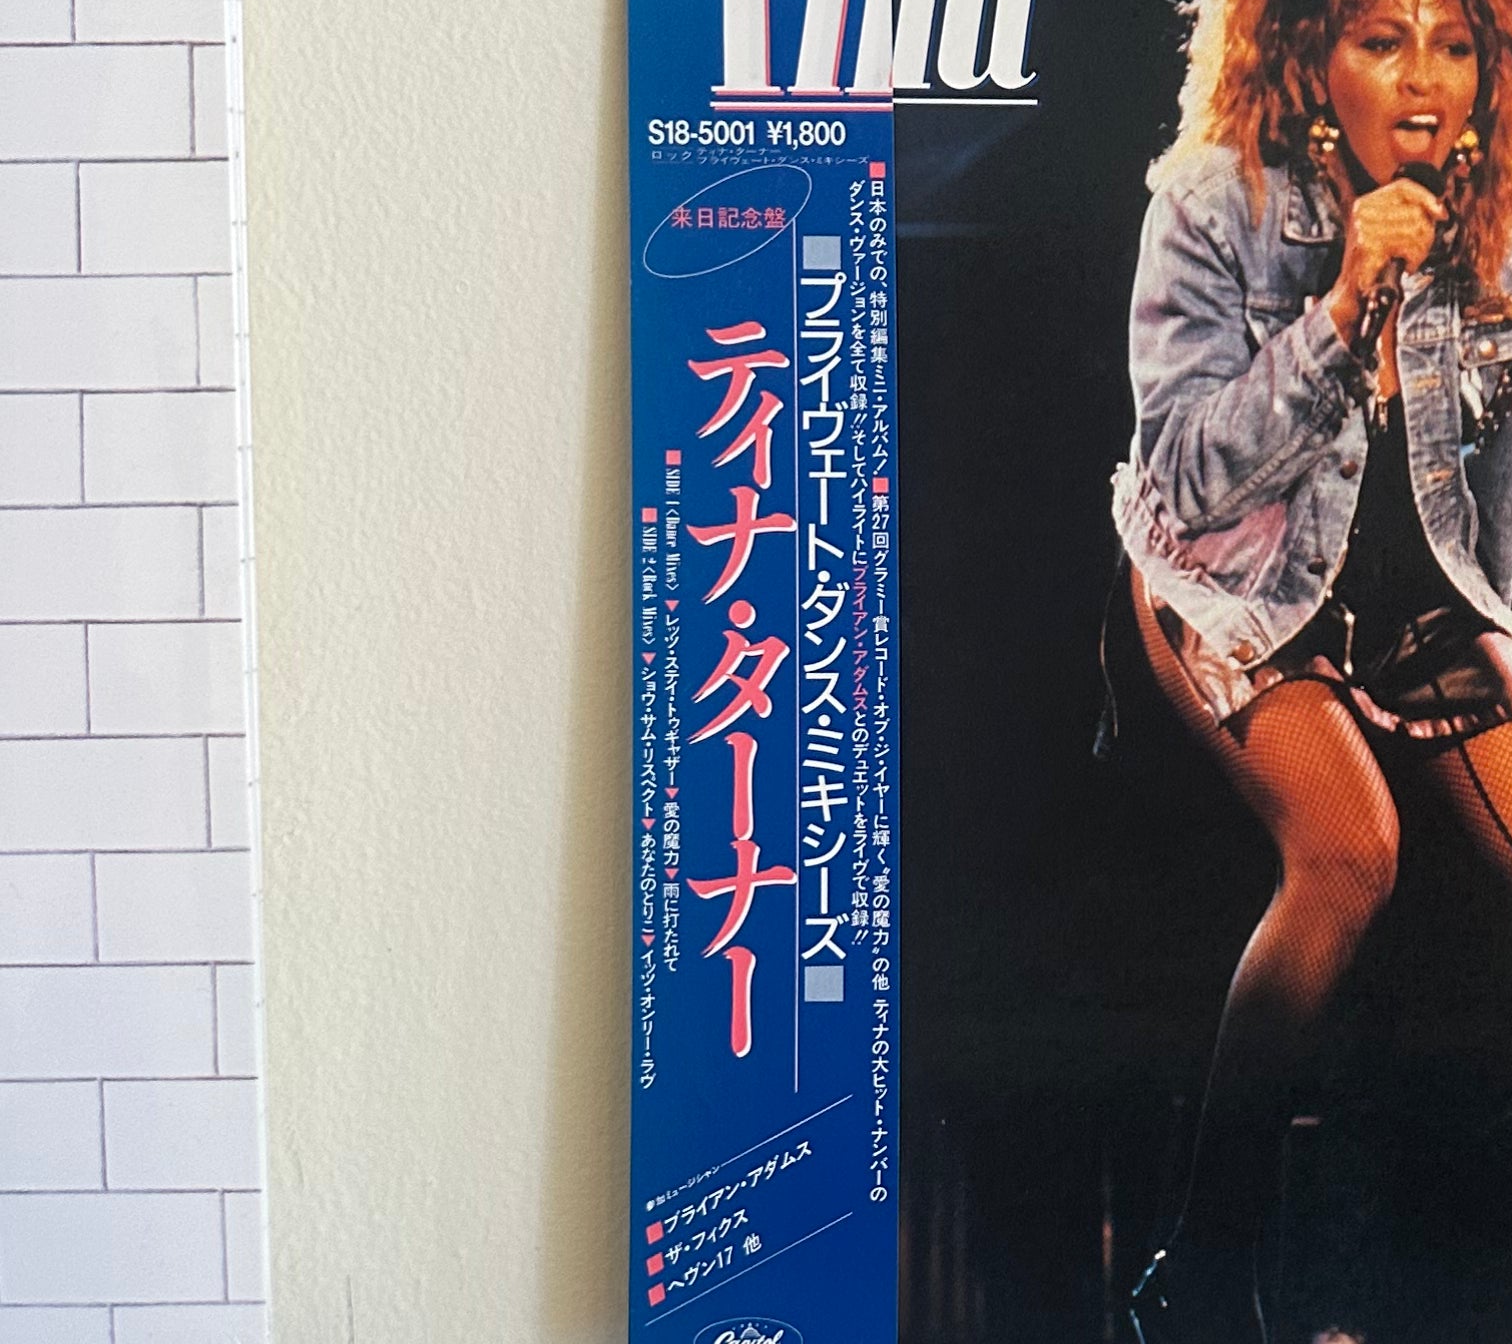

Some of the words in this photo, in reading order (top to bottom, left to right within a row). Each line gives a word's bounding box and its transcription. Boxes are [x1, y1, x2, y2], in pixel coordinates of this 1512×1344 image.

[647, 118, 755, 146] S18-5001
[766, 119, 847, 151] ¥1,800
[670, 206, 787, 230] 来日記念盤
[664, 467, 681, 496] SIDE
[641, 526, 658, 553] SIDE
[799, 271, 849, 961] プライヴェート・ダンス・ミキシーズ
[685, 320, 798, 1059] ティナ・ターナー
[662, 801, 681, 866] 愛の魔力
[640, 832, 657, 934] あなたのとりこ
[662, 882, 681, 973] 雨に打たれて
[663, 1140, 813, 1234] ブライアン・アダムス
[664, 1208, 750, 1265] ザ・フィクス
[742, 1232, 763, 1256] 他
